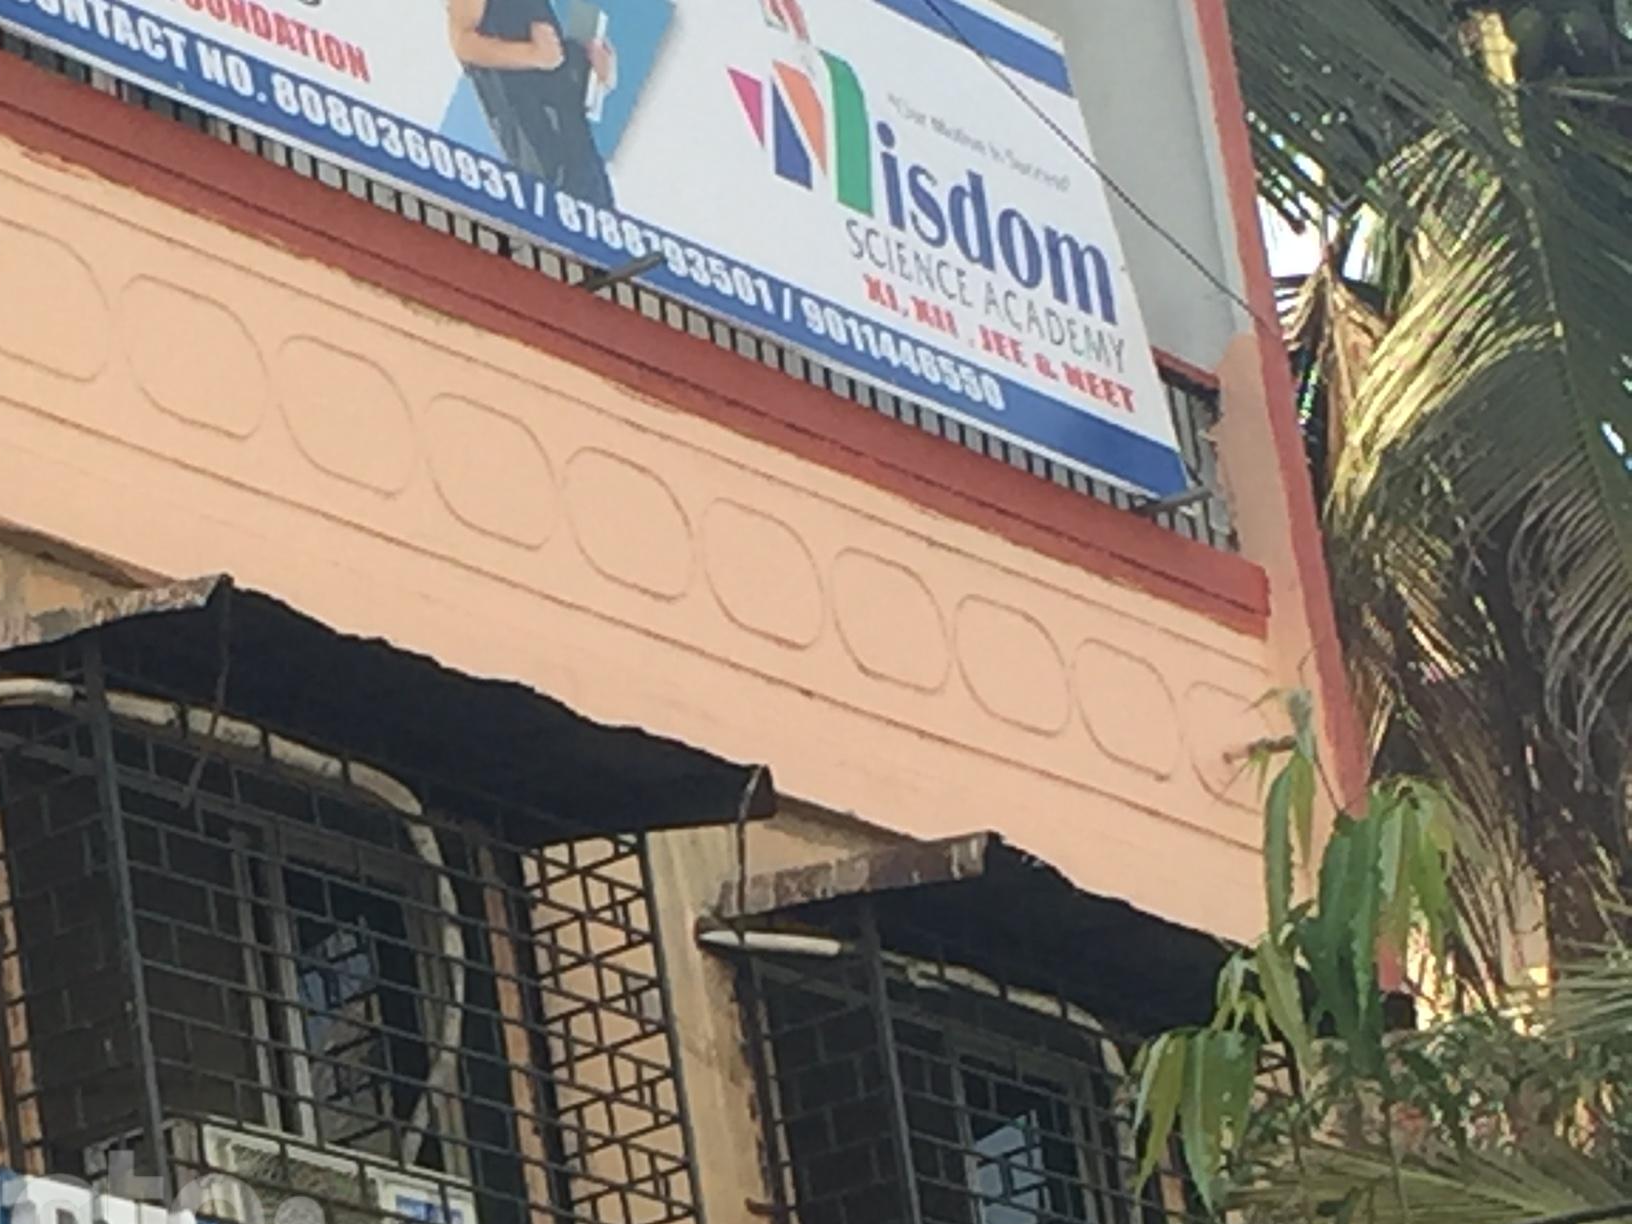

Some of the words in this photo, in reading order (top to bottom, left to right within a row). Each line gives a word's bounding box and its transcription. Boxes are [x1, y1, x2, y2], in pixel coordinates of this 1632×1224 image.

[16, 0, 188, 71] NTACT
[196, 40, 267, 102] NO.
[182, 0, 370, 82] UNDATION
[845, 218, 974, 309] SCIENCE
[983, 280, 1126, 374] ACADEMY
[1060, 361, 1135, 413] NEET
